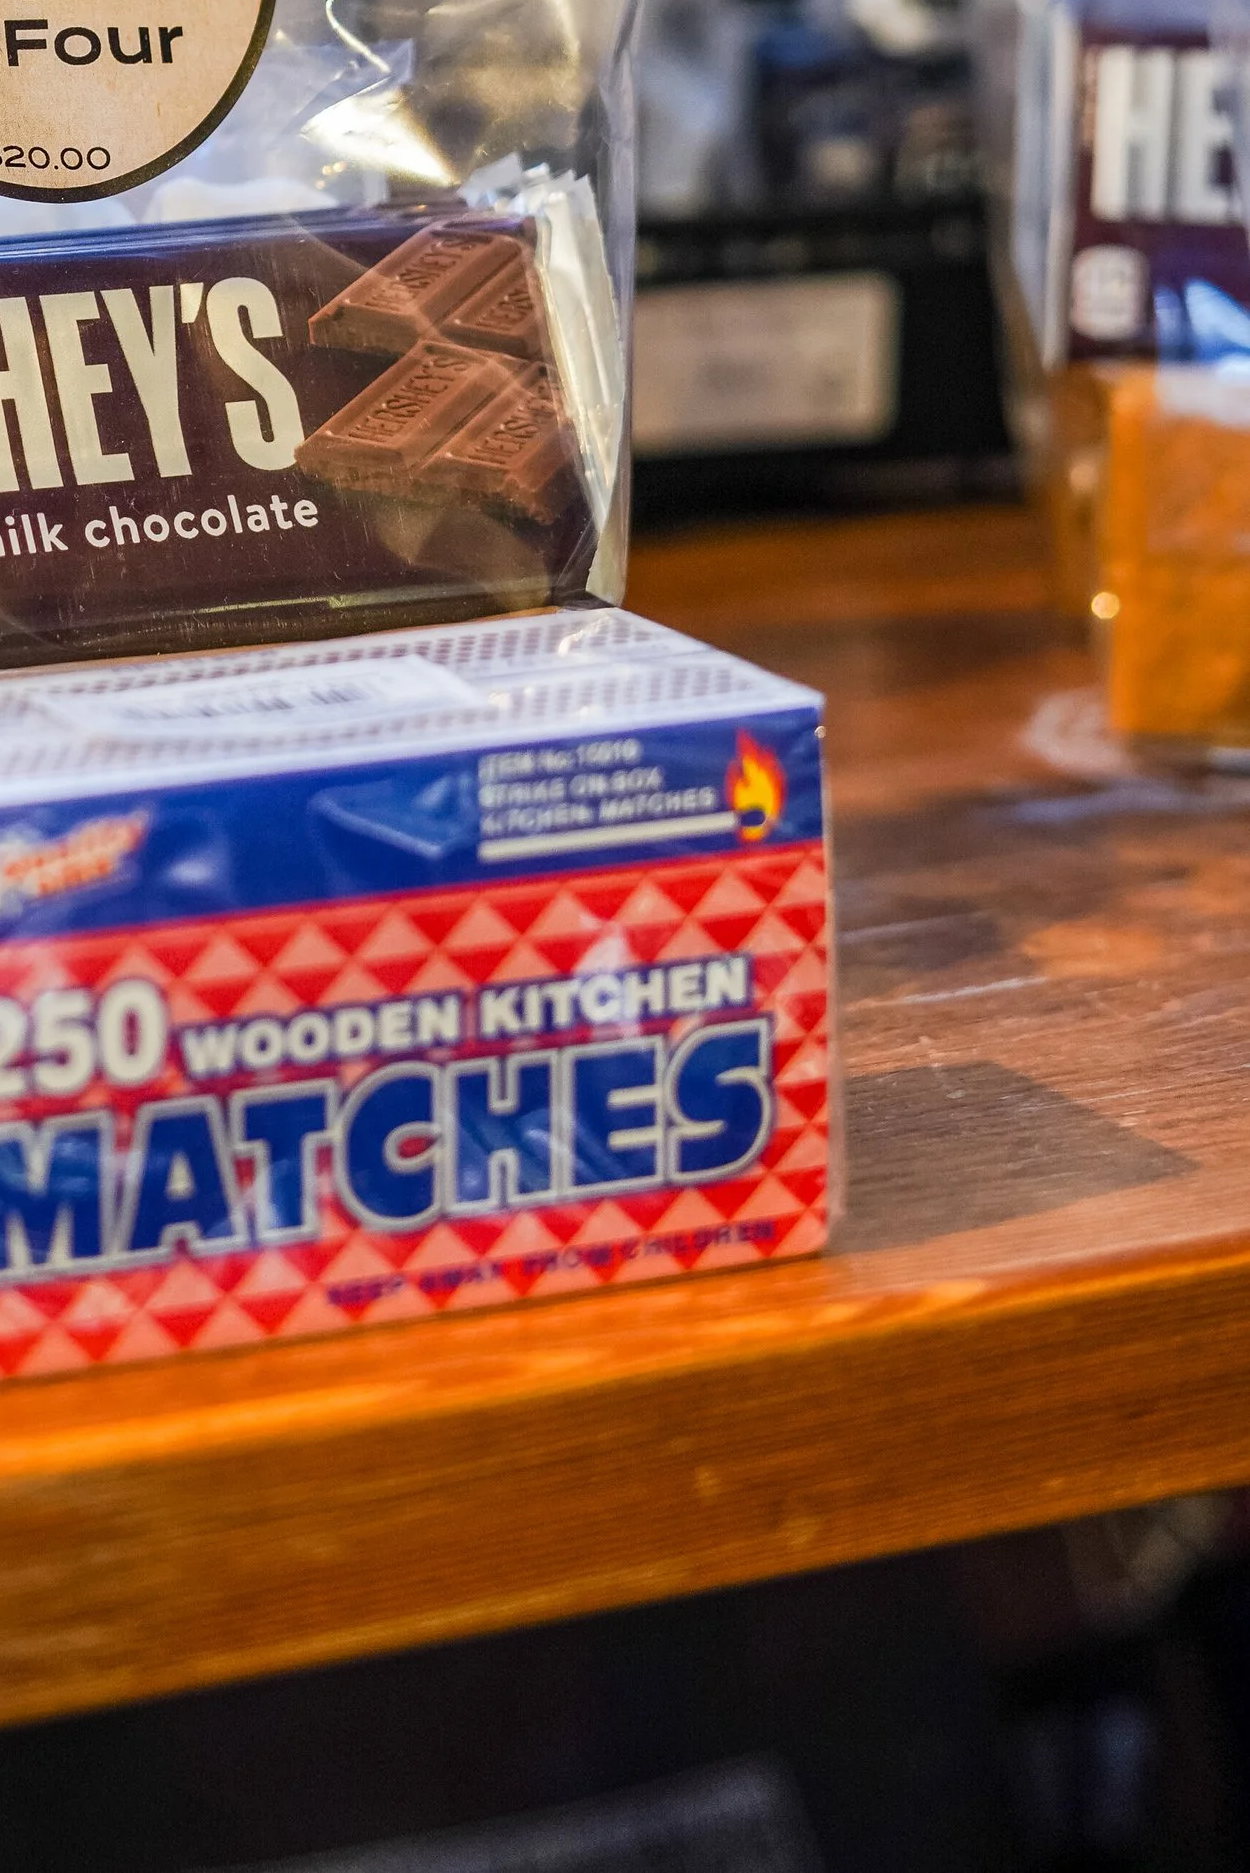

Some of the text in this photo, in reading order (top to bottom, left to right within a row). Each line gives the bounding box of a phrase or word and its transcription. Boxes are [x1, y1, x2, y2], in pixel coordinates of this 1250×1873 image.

[5, 18, 184, 67] Four
[84, 492, 321, 550] chocolate
[181, 994, 461, 1078] WOODEN
[480, 954, 748, 1038] KITCHEN
